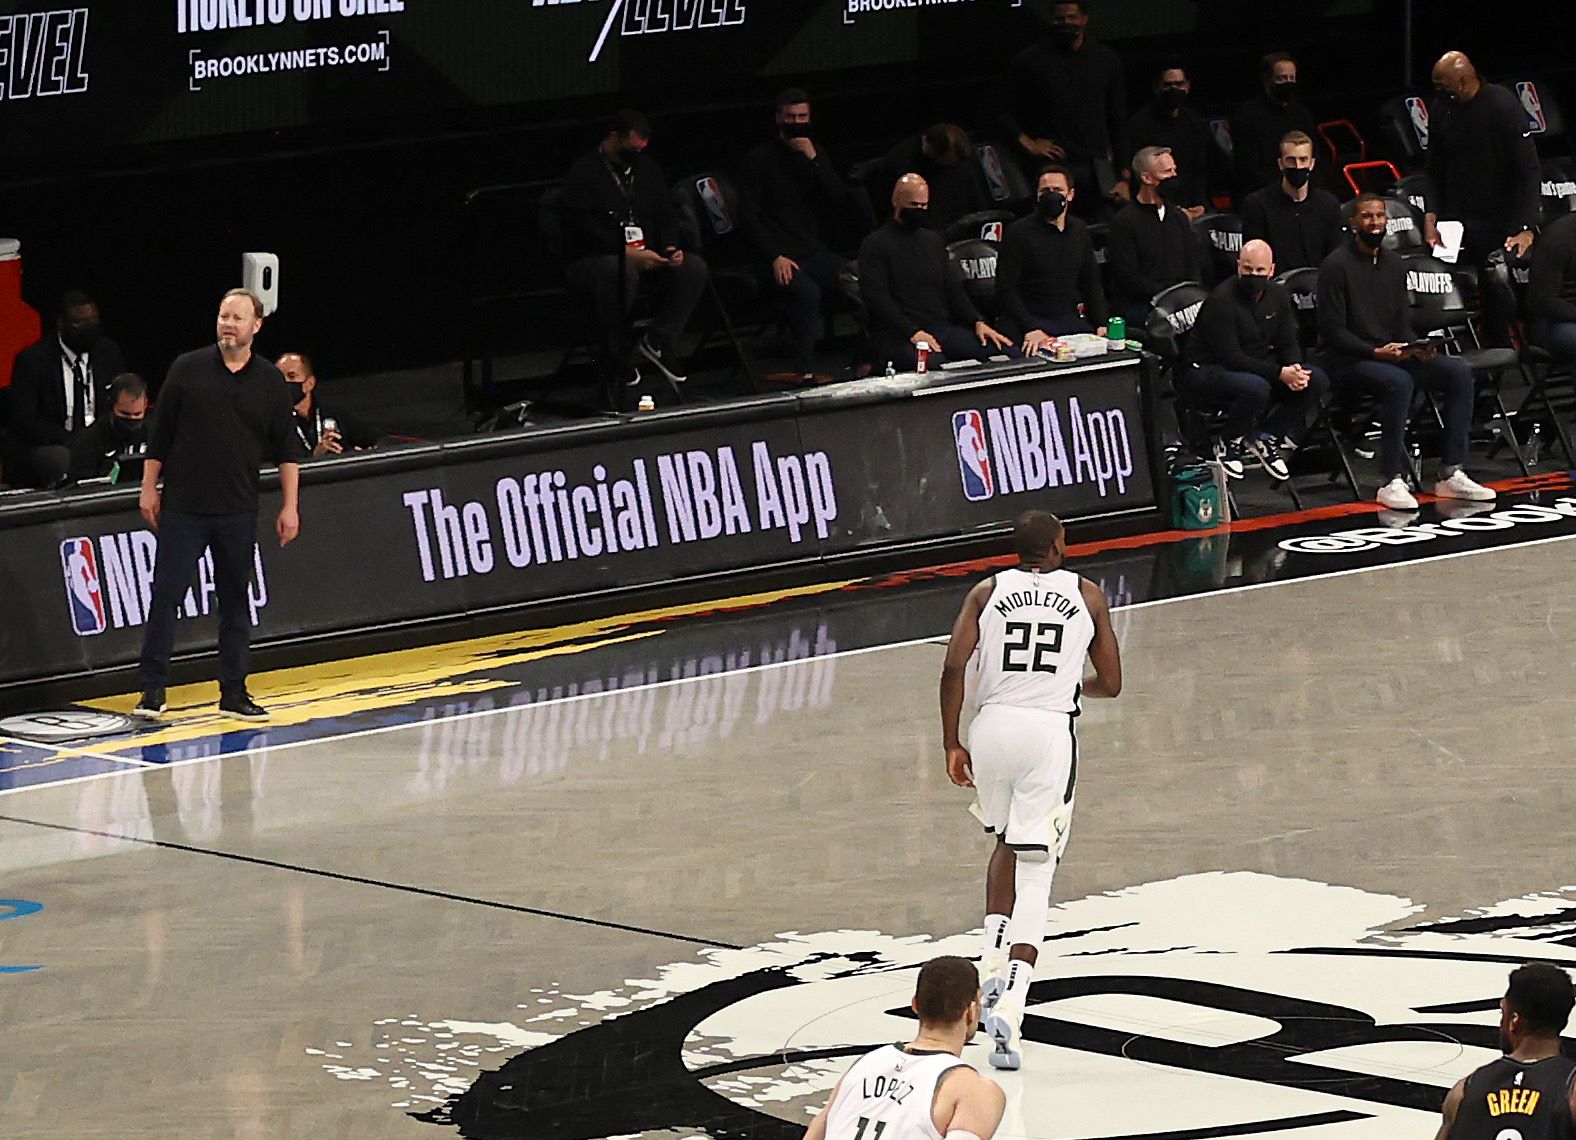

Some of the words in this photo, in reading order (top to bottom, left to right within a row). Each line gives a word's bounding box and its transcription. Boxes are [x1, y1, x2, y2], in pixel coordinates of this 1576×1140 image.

[194, 42, 385, 79] BROOKLYNNETS.COM
[986, 400, 1073, 495] NBA
[1069, 397, 1133, 497] App
[403, 488, 495, 582] The
[497, 457, 659, 569] Official
[656, 443, 751, 545] NBA
[751, 440, 838, 543] App
[994, 590, 1080, 621] MIDDLETON
[1001, 621, 1064, 675] 22
[862, 1074, 914, 1106] LOPEZ
[1486, 1088, 1541, 1118] GREEN
